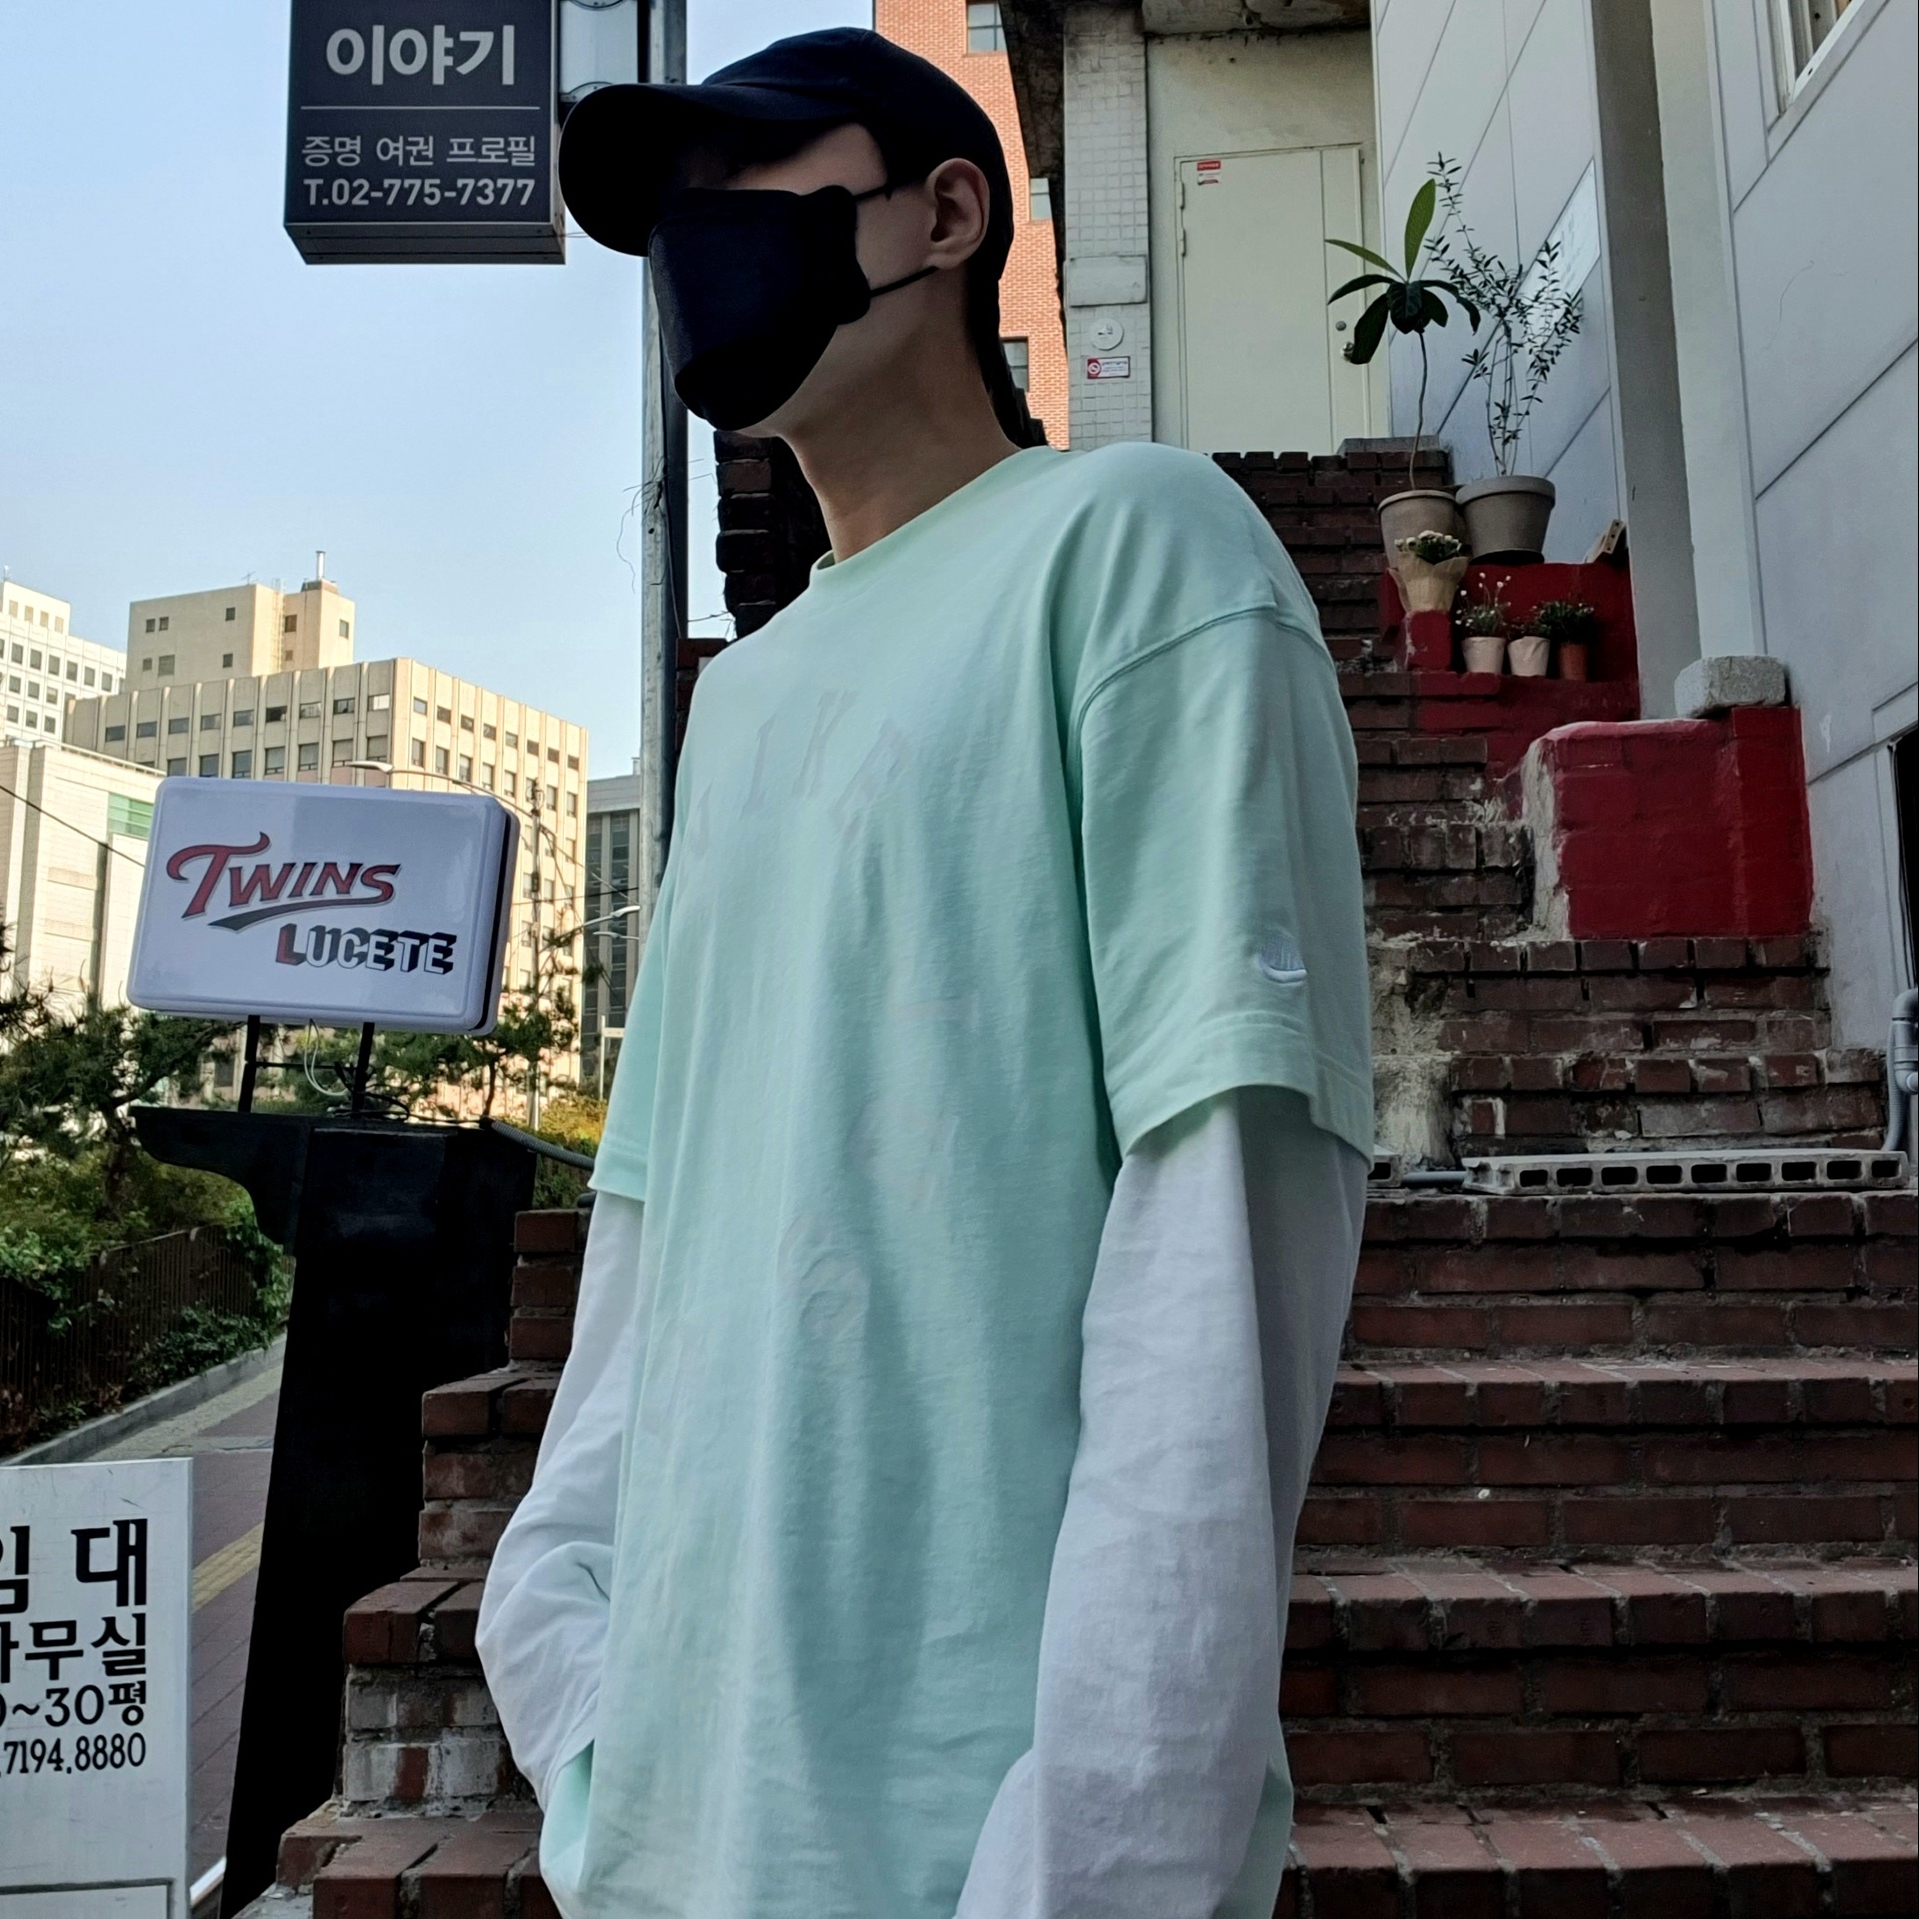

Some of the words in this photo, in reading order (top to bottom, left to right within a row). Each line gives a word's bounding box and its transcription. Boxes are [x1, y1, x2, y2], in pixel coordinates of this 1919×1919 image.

[326, 25, 515, 85] 이야기
[302, 135, 361, 167] 증명
[376, 135, 434, 166] 여권
[446, 135, 535, 166] 프로필
[303, 178, 536, 206] T.02-775-7377
[275, 923, 457, 976] LUCETE
